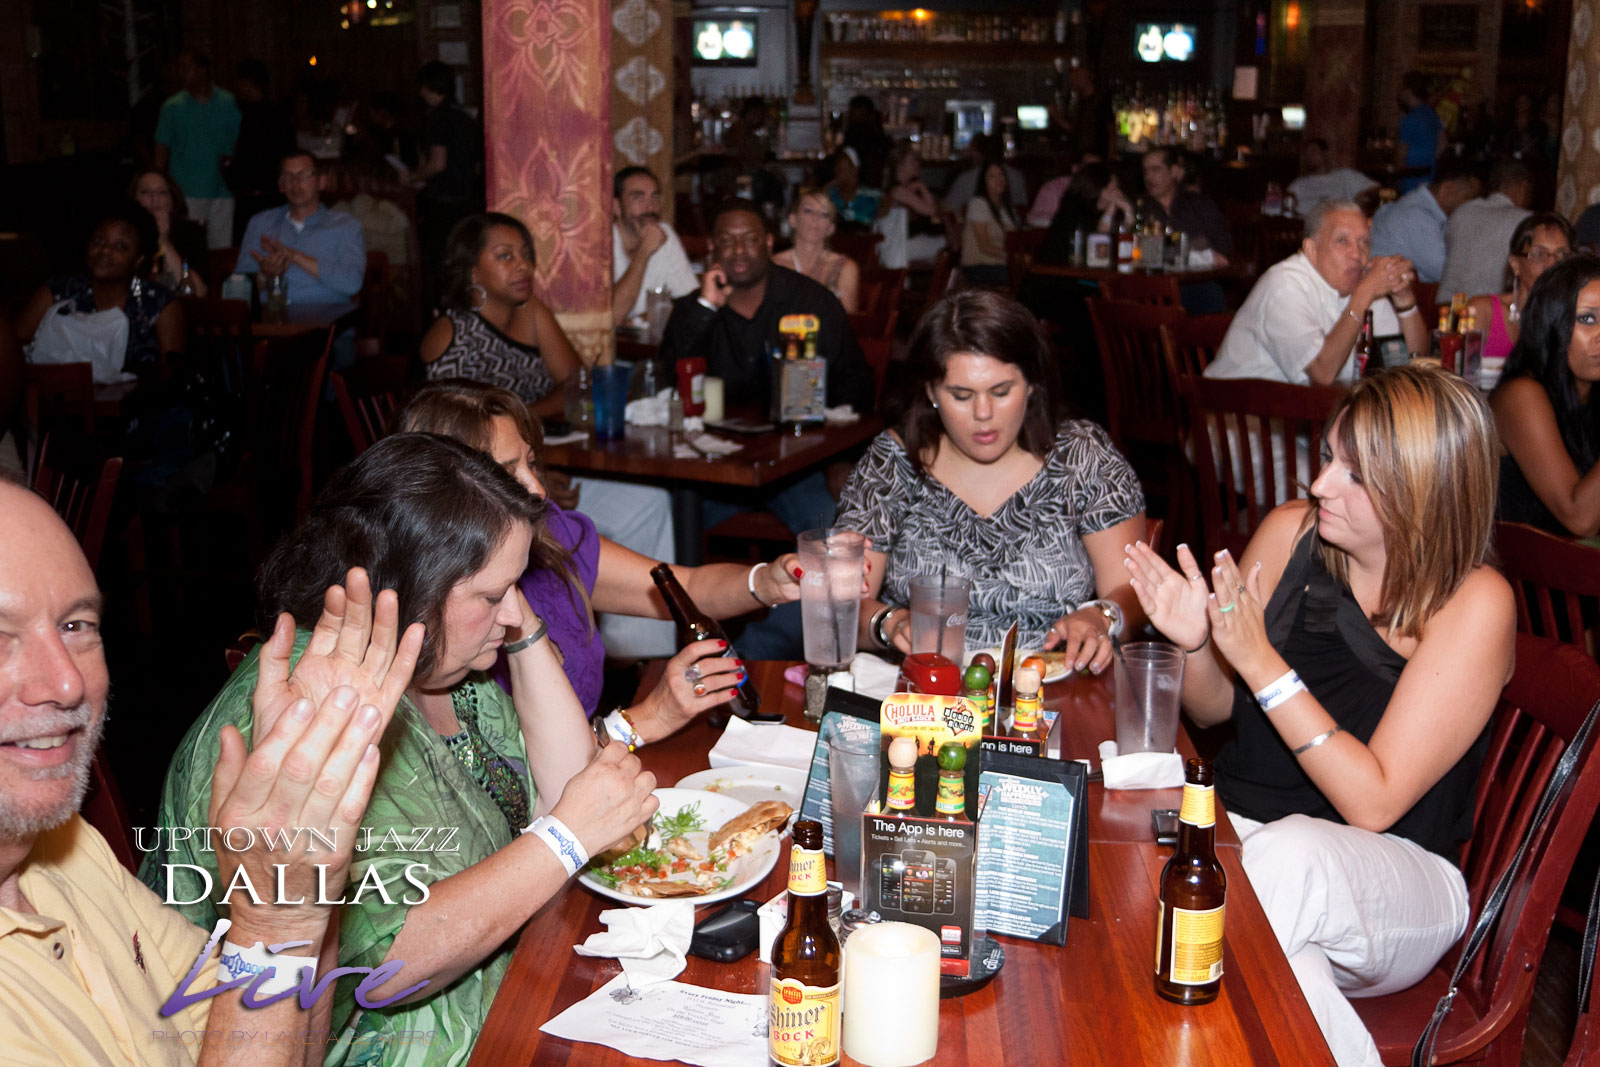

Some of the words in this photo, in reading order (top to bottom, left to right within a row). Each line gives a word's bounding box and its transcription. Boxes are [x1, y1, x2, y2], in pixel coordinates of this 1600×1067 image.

[884, 703, 935, 722] CHOLULA
[943, 706, 974, 725] HOUSE
[947, 719, 975, 733] BLUES
[998, 741, 1007, 752] is
[1009, 742, 1033, 755] here
[1002, 782, 1043, 795] WEEKLY
[873, 819, 896, 832] The
[898, 821, 923, 837] App
[926, 823, 936, 836] is
[938, 825, 965, 838] here
[871, 834, 889, 842] Tickets
[921, 838, 936, 846] Alerts
[679, 989, 699, 998] Every
[700, 994, 722, 1002] Friday
[770, 1003, 824, 1030] Shiner
[773, 1029, 815, 1041] BOCK
